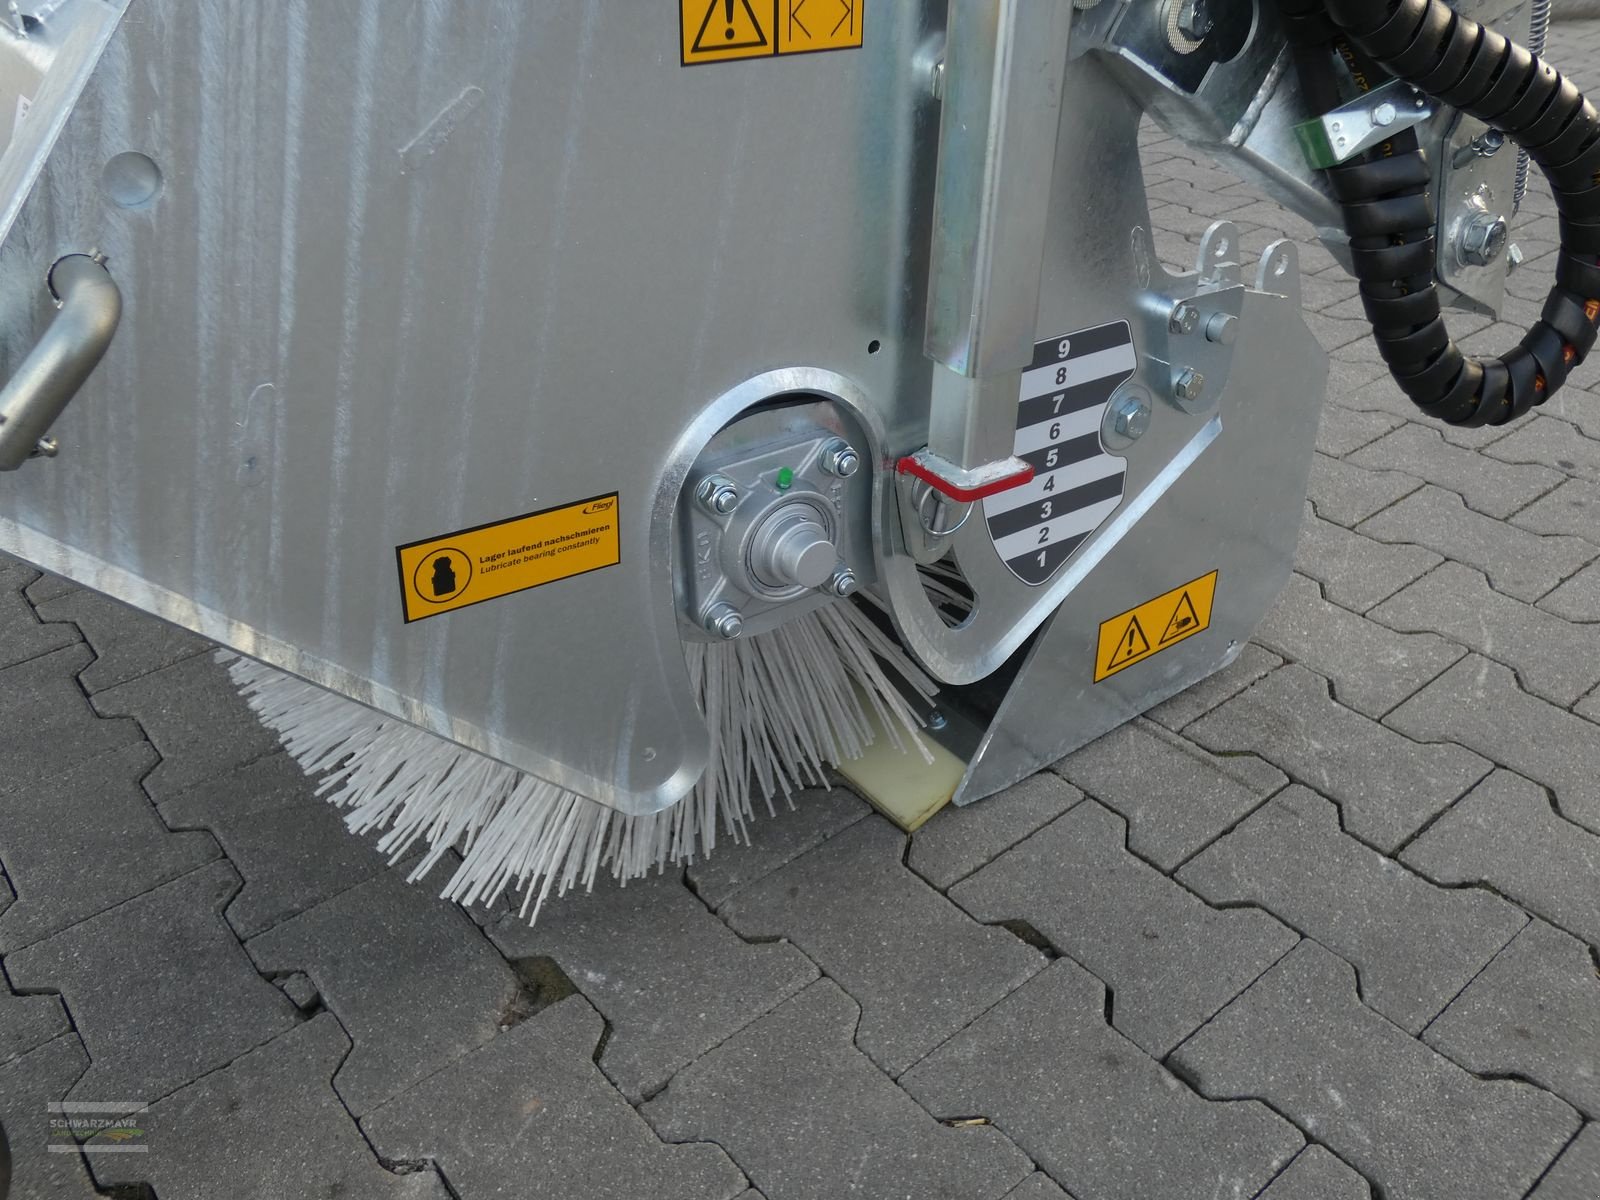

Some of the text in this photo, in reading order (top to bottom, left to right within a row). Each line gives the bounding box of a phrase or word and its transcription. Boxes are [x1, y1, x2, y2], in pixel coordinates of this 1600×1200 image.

[1058, 340, 1071, 358] 9
[1055, 367, 1067, 385] 8
[1052, 394, 1065, 414] 7
[1049, 422, 1061, 440] 6
[1046, 449, 1059, 467] 5
[1043, 475, 1055, 492] 4
[1040, 501, 1052, 519] 3
[479, 524, 610, 563] Lager laufend nachschmieren
[1038, 527, 1050, 544] 2
[480, 536, 601, 574] Lubricate bearing constantly
[1036, 550, 1047, 567] 1
